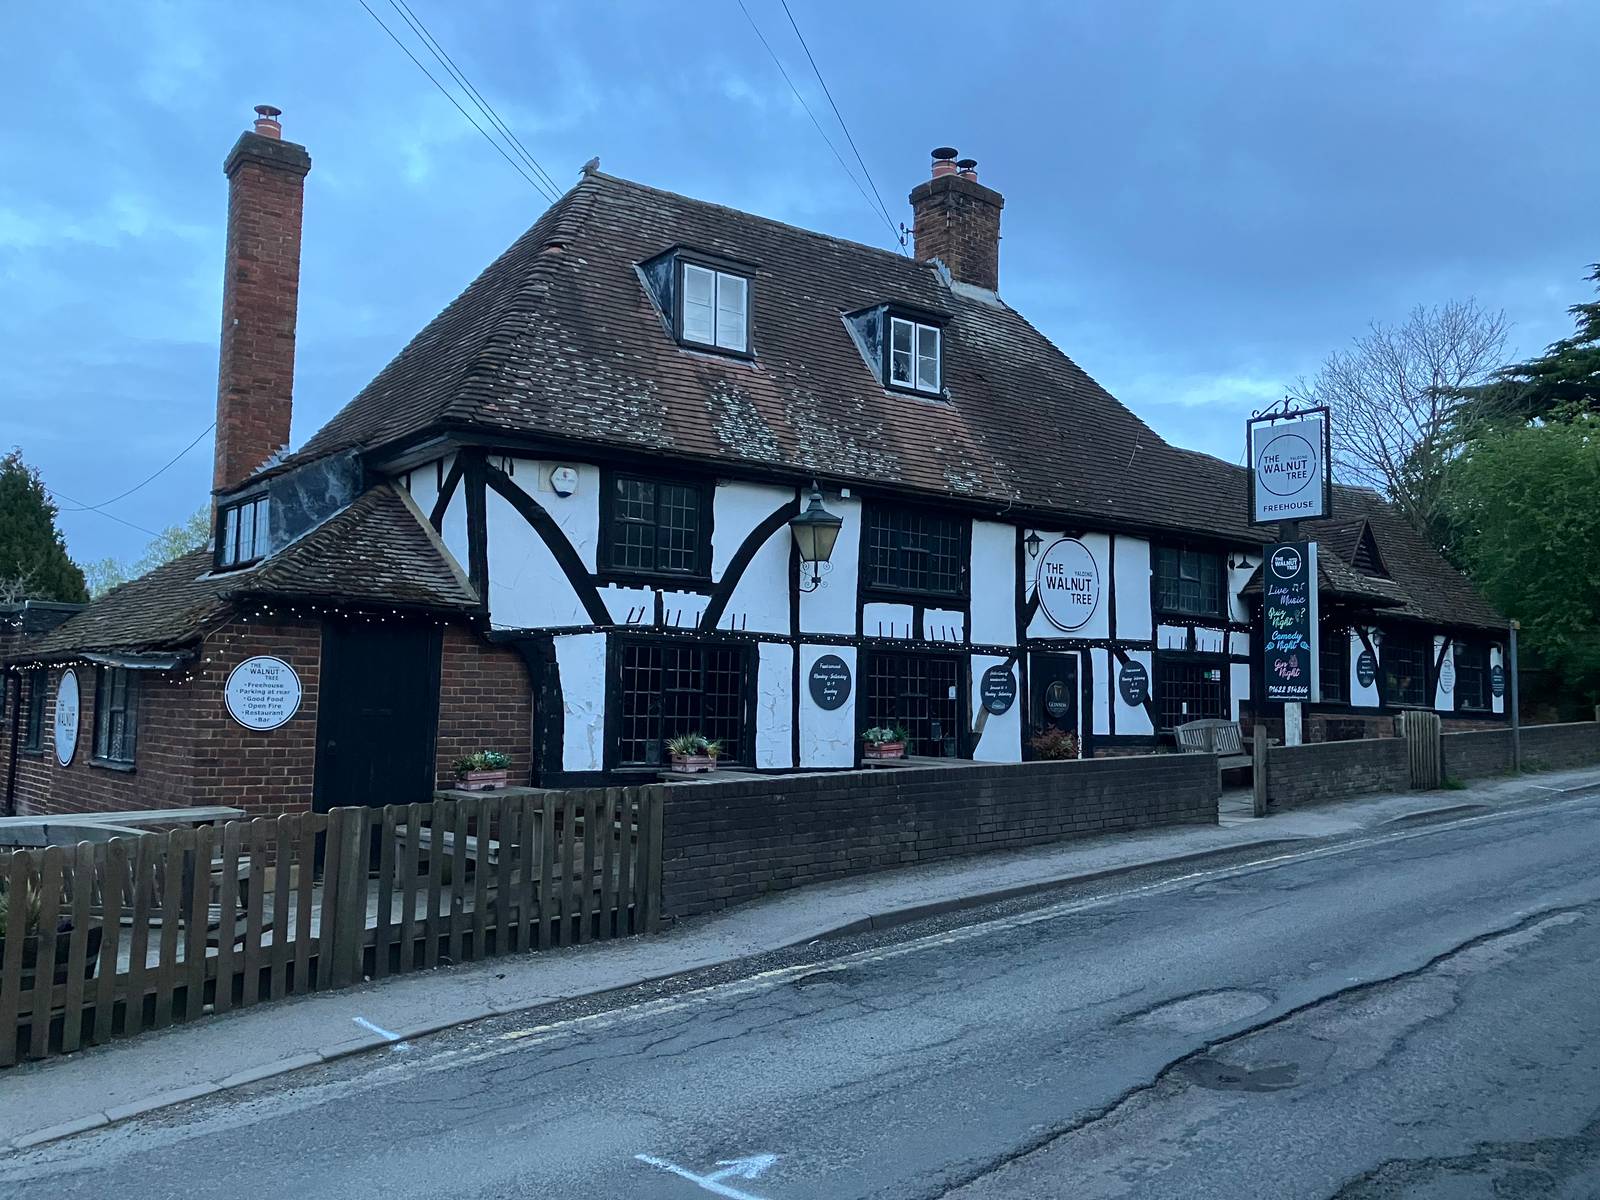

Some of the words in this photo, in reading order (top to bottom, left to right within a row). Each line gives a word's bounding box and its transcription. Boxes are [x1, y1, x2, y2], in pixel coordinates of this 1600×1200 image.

[1264, 455, 1280, 464] THE
[1264, 460, 1308, 474] WALNUT
[1286, 470, 1307, 480] TREE
[1263, 501, 1313, 512] FREEHOUSE
[1046, 562, 1064, 574] THE
[1046, 576, 1092, 592] WALNUT
[1268, 584, 1289, 595] Live
[1071, 593, 1092, 605] TREE
[1281, 595, 1306, 606] Music
[1268, 607, 1286, 619] Quiz
[1272, 617, 1293, 630] Night
[1272, 630, 1303, 642] Comedy
[1277, 641, 1298, 652] Night
[1274, 659, 1288, 672] Gin
[1279, 668, 1300, 680] Night
